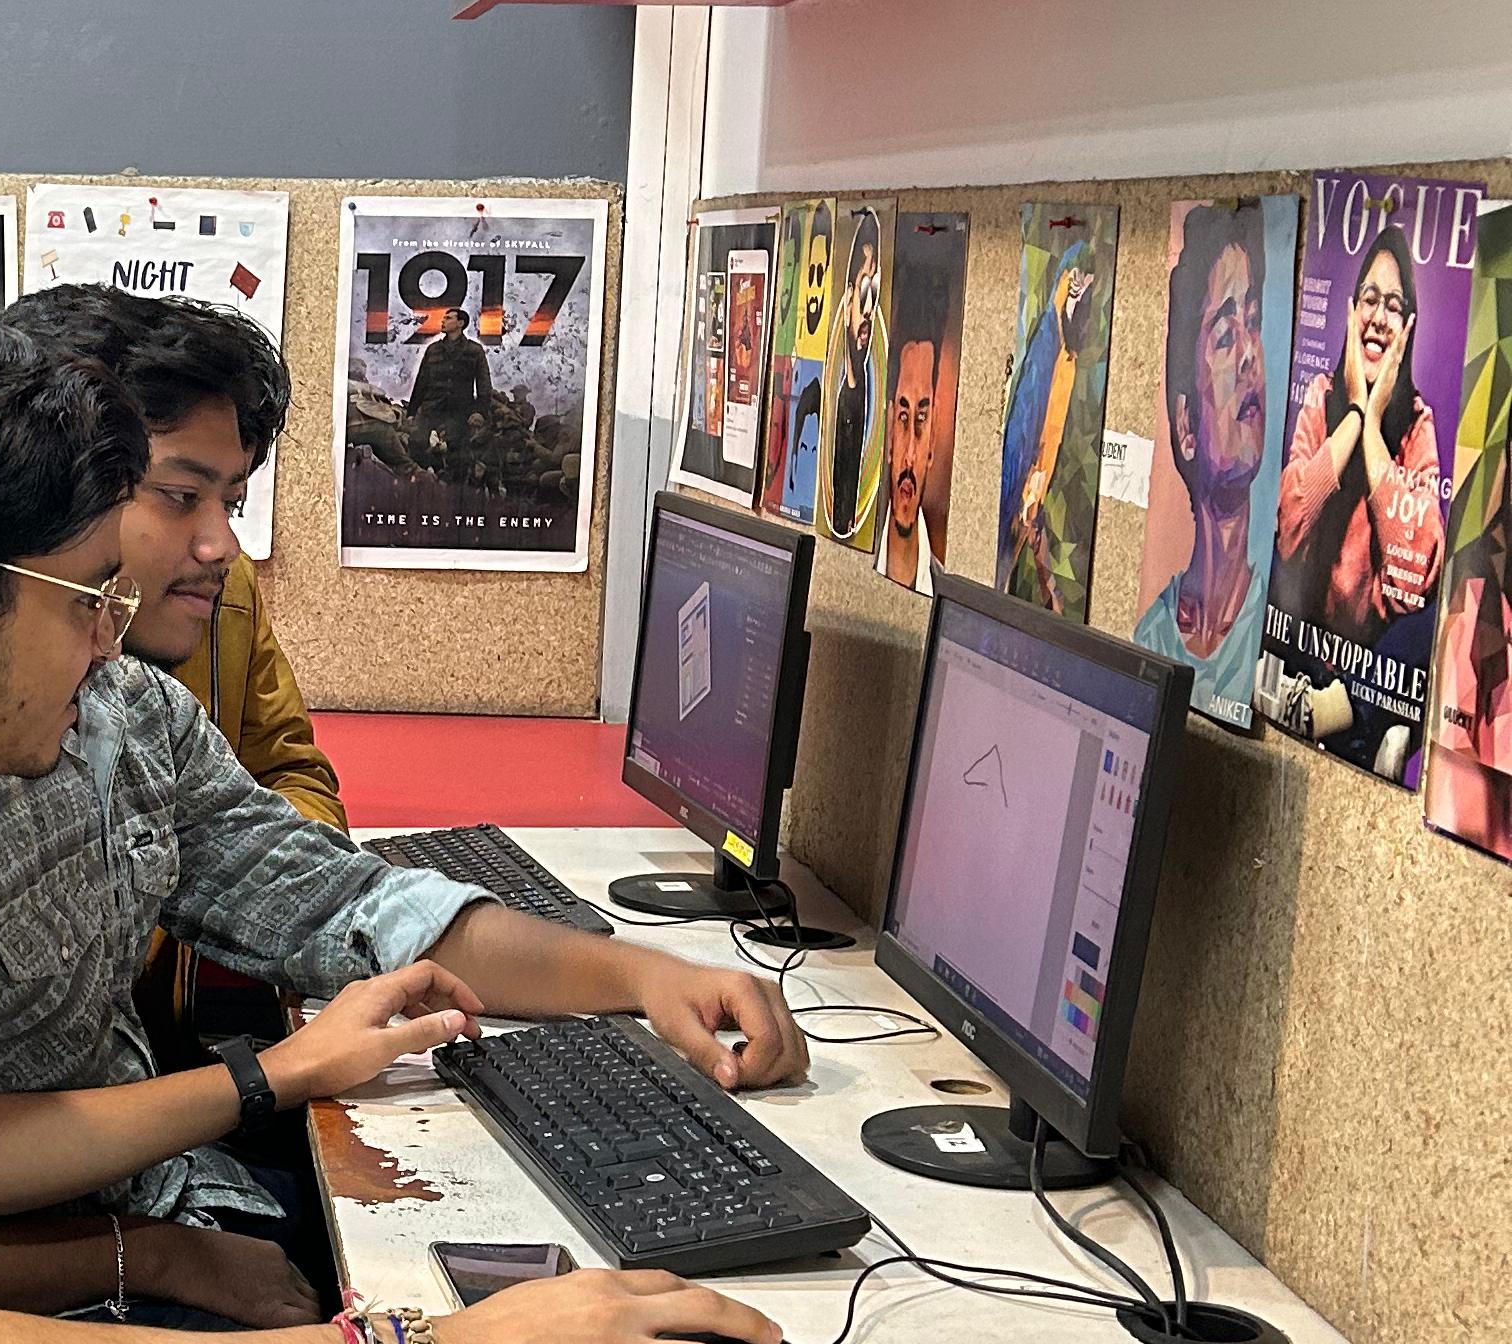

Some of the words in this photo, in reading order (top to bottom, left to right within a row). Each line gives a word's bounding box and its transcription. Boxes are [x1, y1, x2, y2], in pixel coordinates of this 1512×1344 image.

[1316, 178, 1482, 269] VOGUE
[113, 259, 194, 292] NIGHT
[356, 250, 586, 346] 1917
[1295, 351, 1330, 370] FLORENCE
[1370, 459, 1452, 499] SPARKLING
[365, 513, 407, 525] TIME
[421, 515, 440, 526] IS
[455, 515, 485, 527] THE
[499, 517, 553, 528] ENEMY
[1386, 490, 1431, 528] JOY
[1382, 583, 1403, 600] YOUR
[1403, 591, 1426, 608] LIFE
[1266, 604, 1293, 645] THE
[1298, 621, 1427, 703] UNSTOPPABLE
[1209, 694, 1250, 723] ANIKET
[1351, 680, 1377, 706] LUCKY
[1376, 690, 1421, 723] PARASHAR
